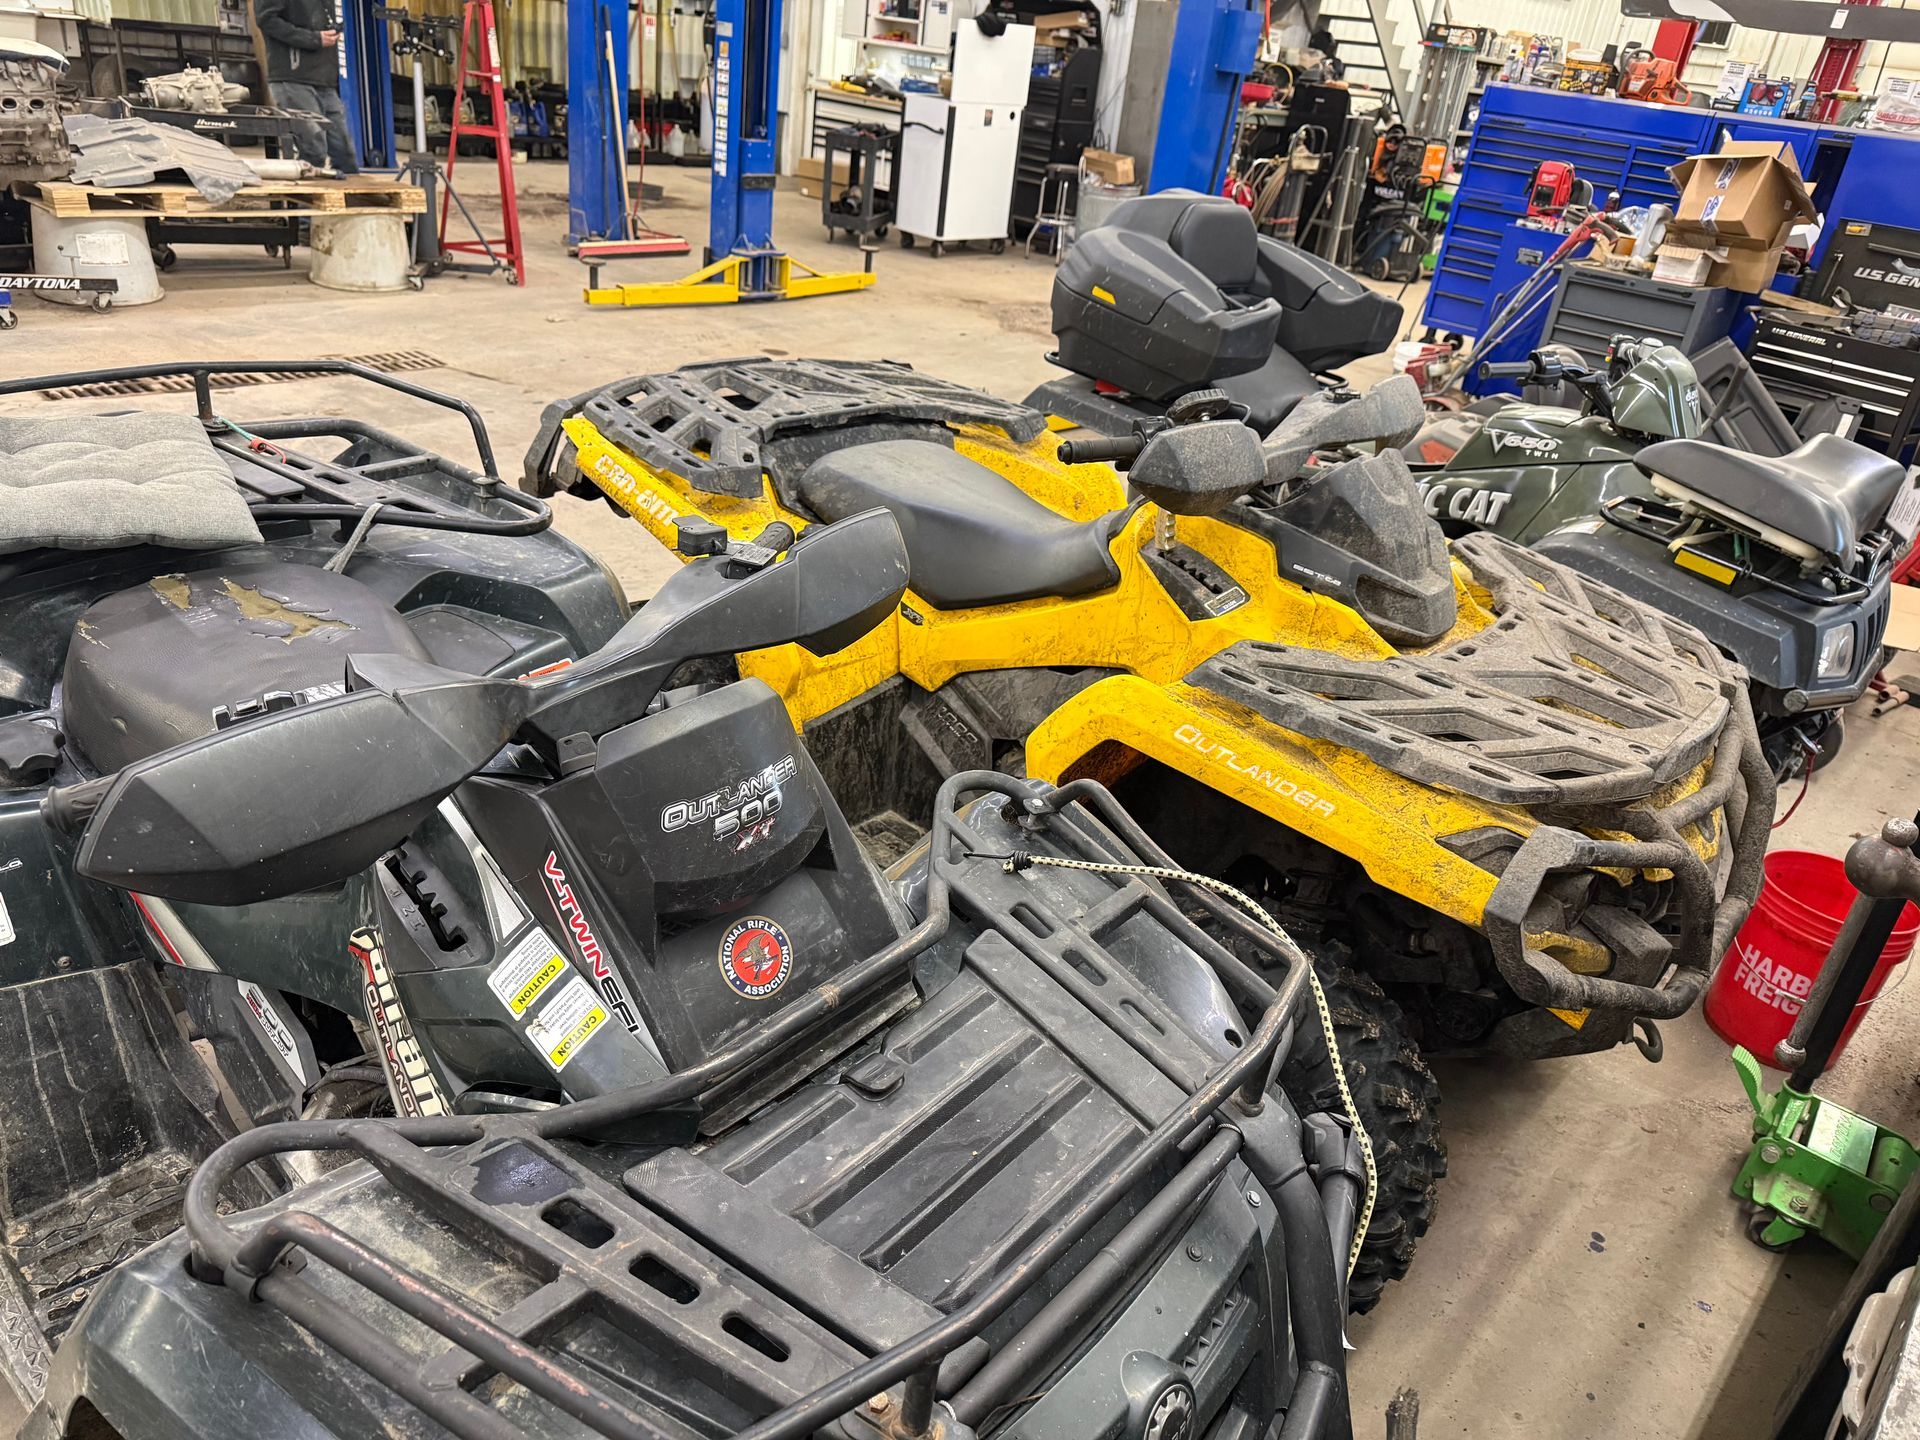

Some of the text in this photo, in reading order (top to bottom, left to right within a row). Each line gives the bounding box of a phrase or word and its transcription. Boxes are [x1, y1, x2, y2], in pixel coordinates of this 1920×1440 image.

[0, 276, 81, 290] DAYTONA
[1526, 449, 1559, 460] TWIN
[1449, 487, 1512, 525] CAT
[661, 754, 798, 833] OUTLANDER
[1173, 723, 1336, 817] OUTLANDER
[713, 789, 783, 841] 500
[723, 920, 790, 995] NATIONAL RIFLE ASSOCIATION
[1742, 943, 1812, 996] HARB
[516, 963, 556, 1005] CAUTION
[1733, 962, 1801, 1016] FREIG
[366, 984, 418, 1117] OUTLAND
[556, 1014, 597, 1057] CAUTION
